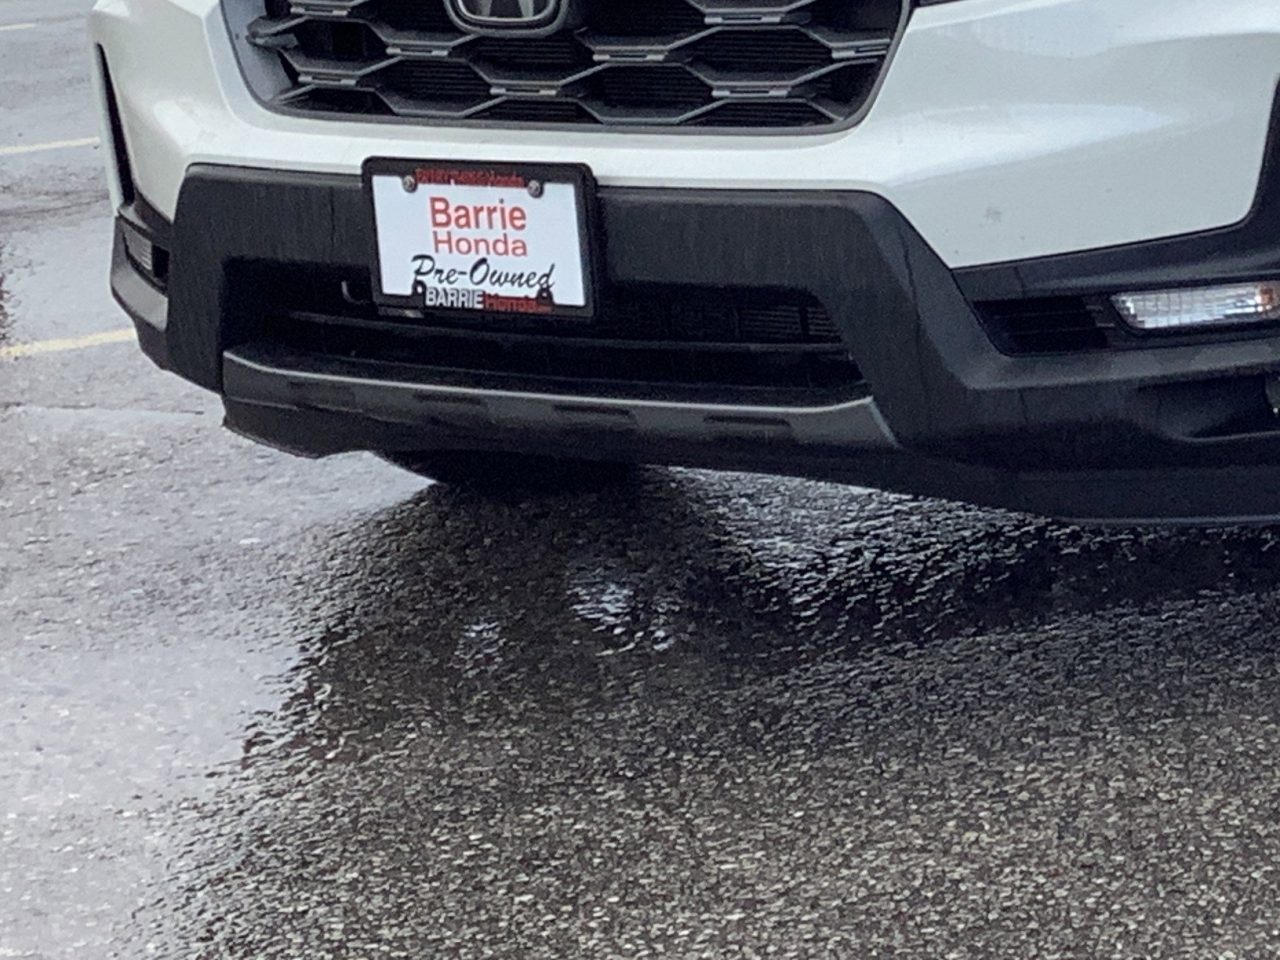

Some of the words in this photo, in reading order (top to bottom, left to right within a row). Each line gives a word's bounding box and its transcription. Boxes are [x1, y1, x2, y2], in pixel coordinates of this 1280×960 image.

[430, 196, 527, 231] Barrie
[433, 231, 528, 257] Honda
[411, 254, 556, 289] Pre-Owned
[425, 287, 484, 309] BARRIE
